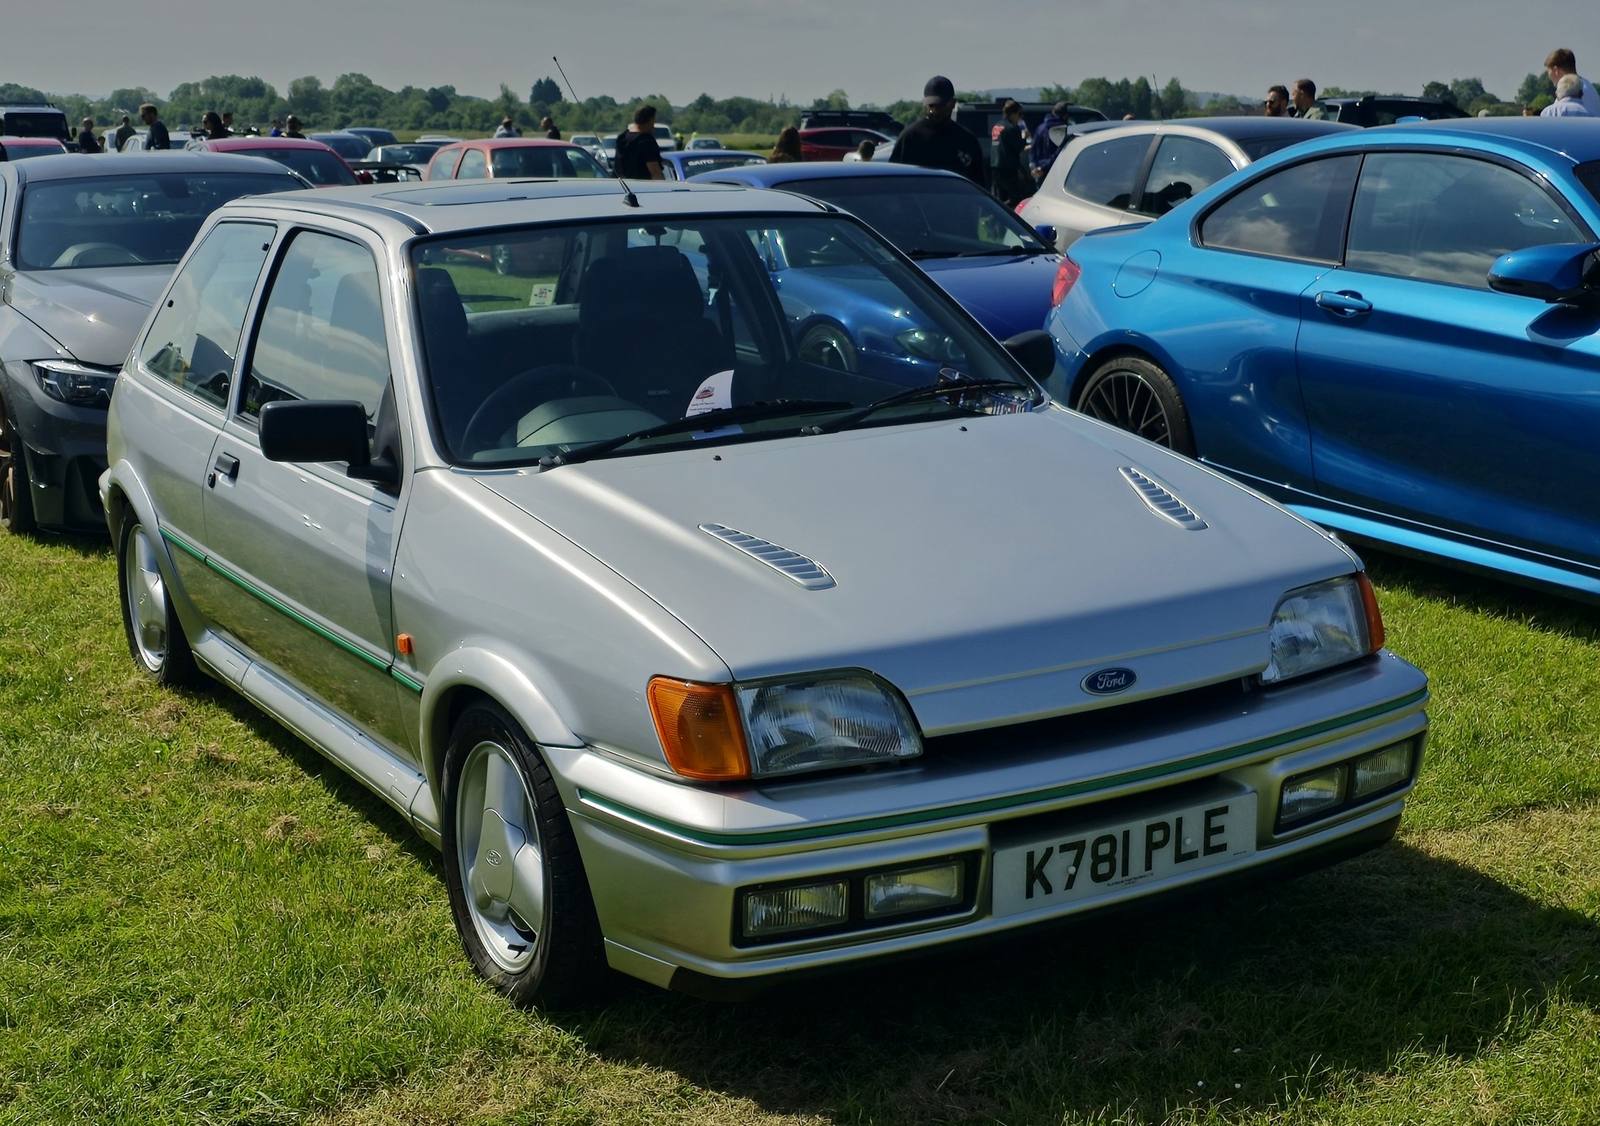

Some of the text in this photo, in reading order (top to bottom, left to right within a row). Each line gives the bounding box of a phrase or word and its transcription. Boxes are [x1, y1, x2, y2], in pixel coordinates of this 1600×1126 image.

[1097, 671, 1126, 689] Ford
[1025, 805, 1229, 899] K781 PLE
